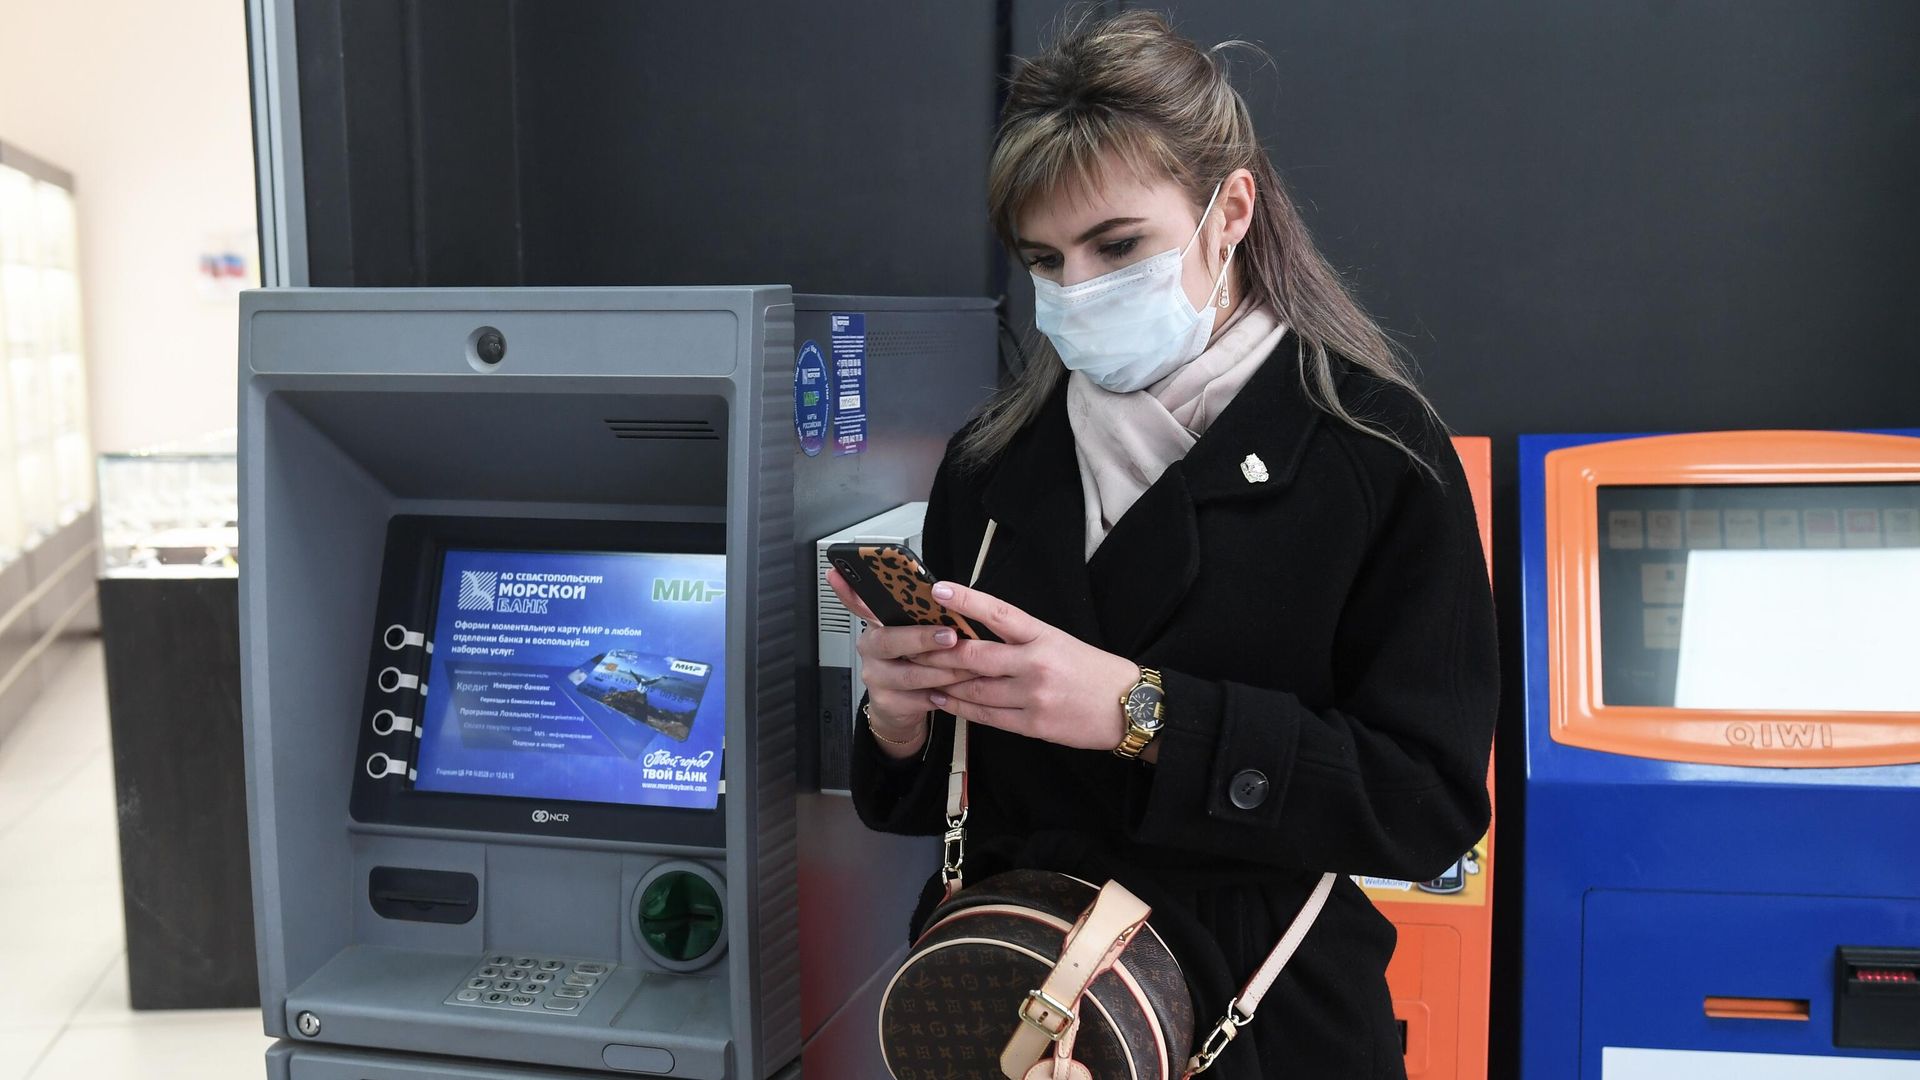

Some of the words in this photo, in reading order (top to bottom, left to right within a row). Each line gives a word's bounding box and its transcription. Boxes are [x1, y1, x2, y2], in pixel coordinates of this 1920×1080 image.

[501, 572, 514, 581] АО
[499, 582, 586, 600] МОРСКОЙ
[497, 598, 549, 614] БАНК
[455, 620, 490, 631] Оформи
[491, 623, 556, 634] моментальную
[557, 625, 581, 636] карту
[582, 625, 604, 635] МИР
[604, 627, 610, 635] в
[611, 627, 642, 637] любом
[453, 633, 497, 643] отделении
[498, 634, 523, 644] банка
[532, 637, 590, 648] воспользуйся
[451, 645, 489, 656] набором
[490, 647, 515, 657] услуг:
[456, 681, 489, 693] Кредит
[493, 682, 551, 692] Интернет-банкинг
[460, 707, 499, 718] Программа
[499, 709, 540, 720] Лояльности
[1725, 722, 1833, 750] QIWI
[643, 749, 681, 768] Твой
[680, 750, 714, 772] город
[642, 767, 674, 781] ТВОЙ
[675, 770, 708, 783] БАНК
[549, 812, 570, 823] NCR
[1364, 877, 1409, 888] WebMoney
